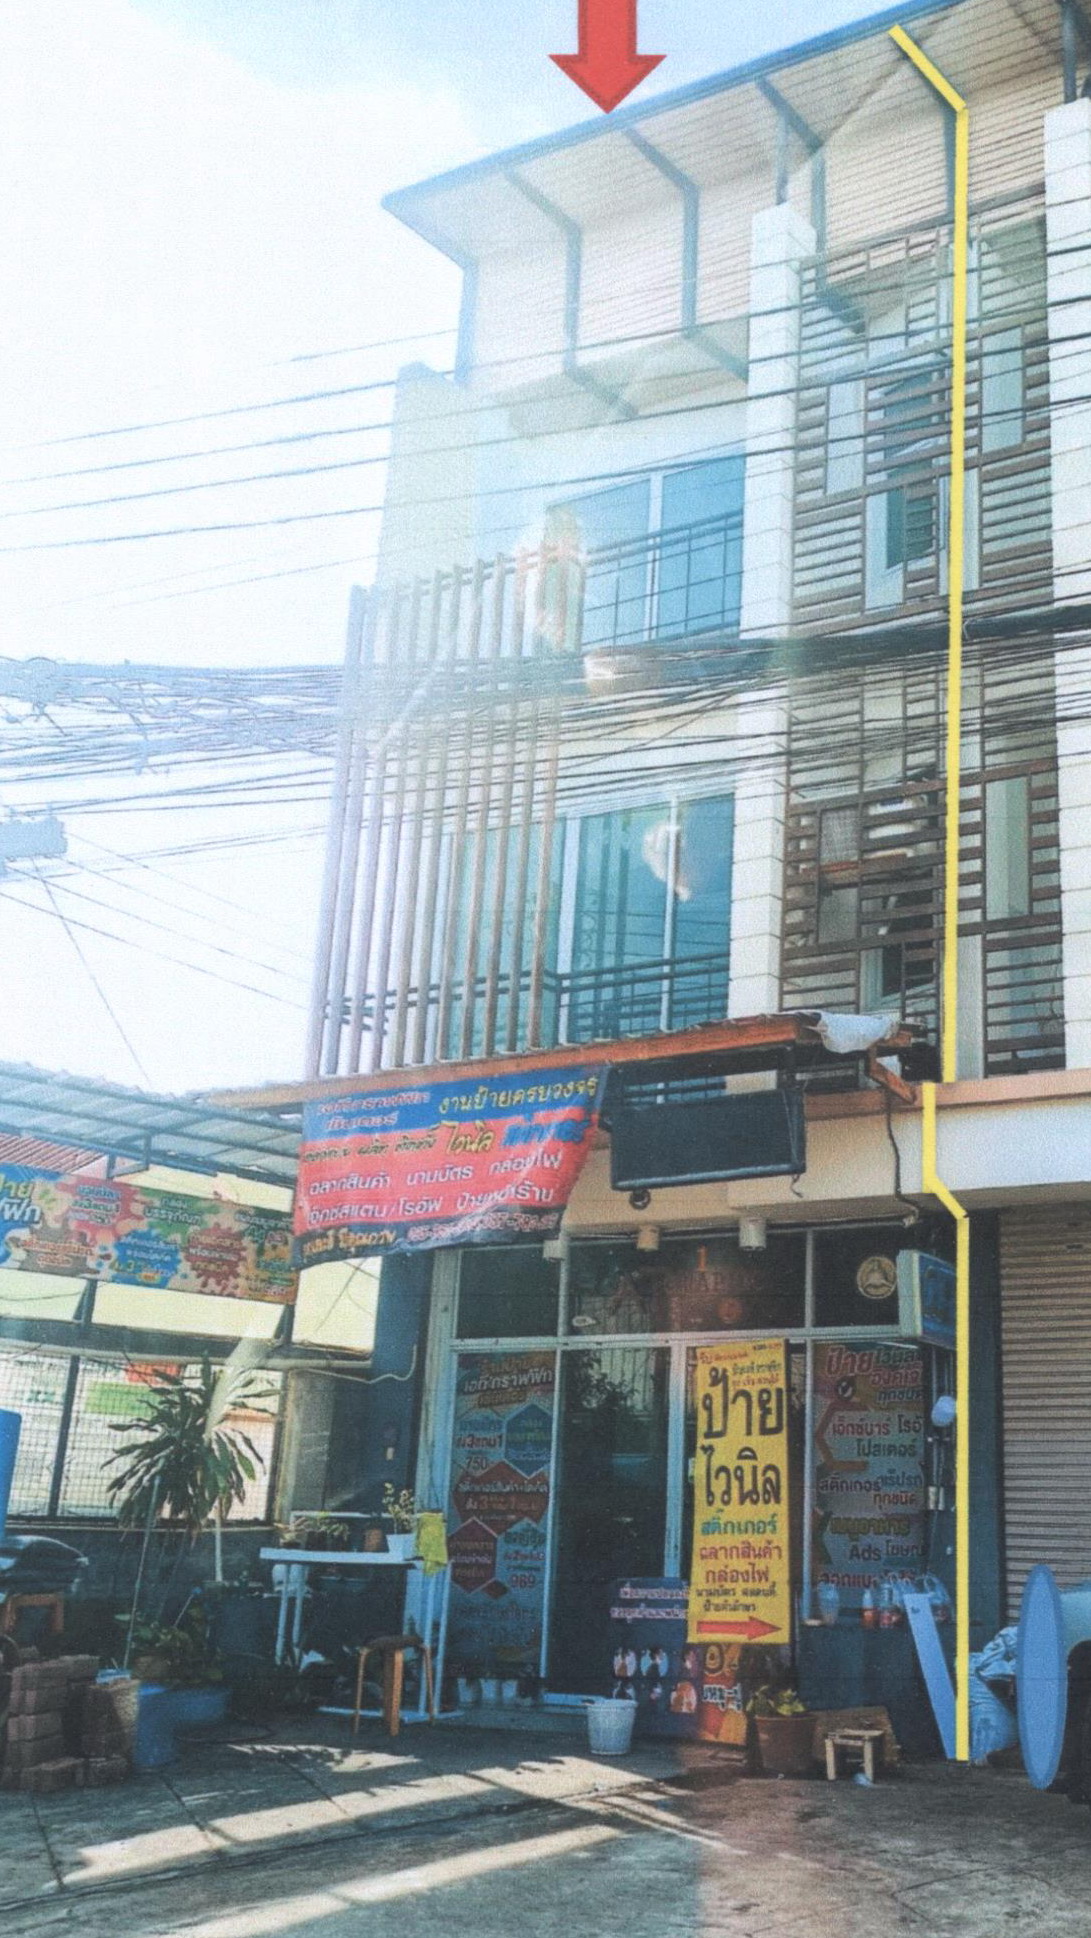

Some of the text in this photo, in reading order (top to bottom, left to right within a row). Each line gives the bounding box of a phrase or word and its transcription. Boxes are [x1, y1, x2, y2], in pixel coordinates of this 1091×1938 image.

[406, 1163, 474, 1185] นามบัตร
[488, 1150, 563, 1176] กล่องไฟ
[701, 1366, 784, 1439] ป้าย
[700, 1443, 782, 1508] ไวนิล
[701, 1508, 778, 1536] สติ๊กเกอร์
[699, 1538, 783, 1561] ฉลากสินค้า
[850, 1543, 882, 1562] Ads
[705, 1562, 769, 1584] กล่องไฟ
